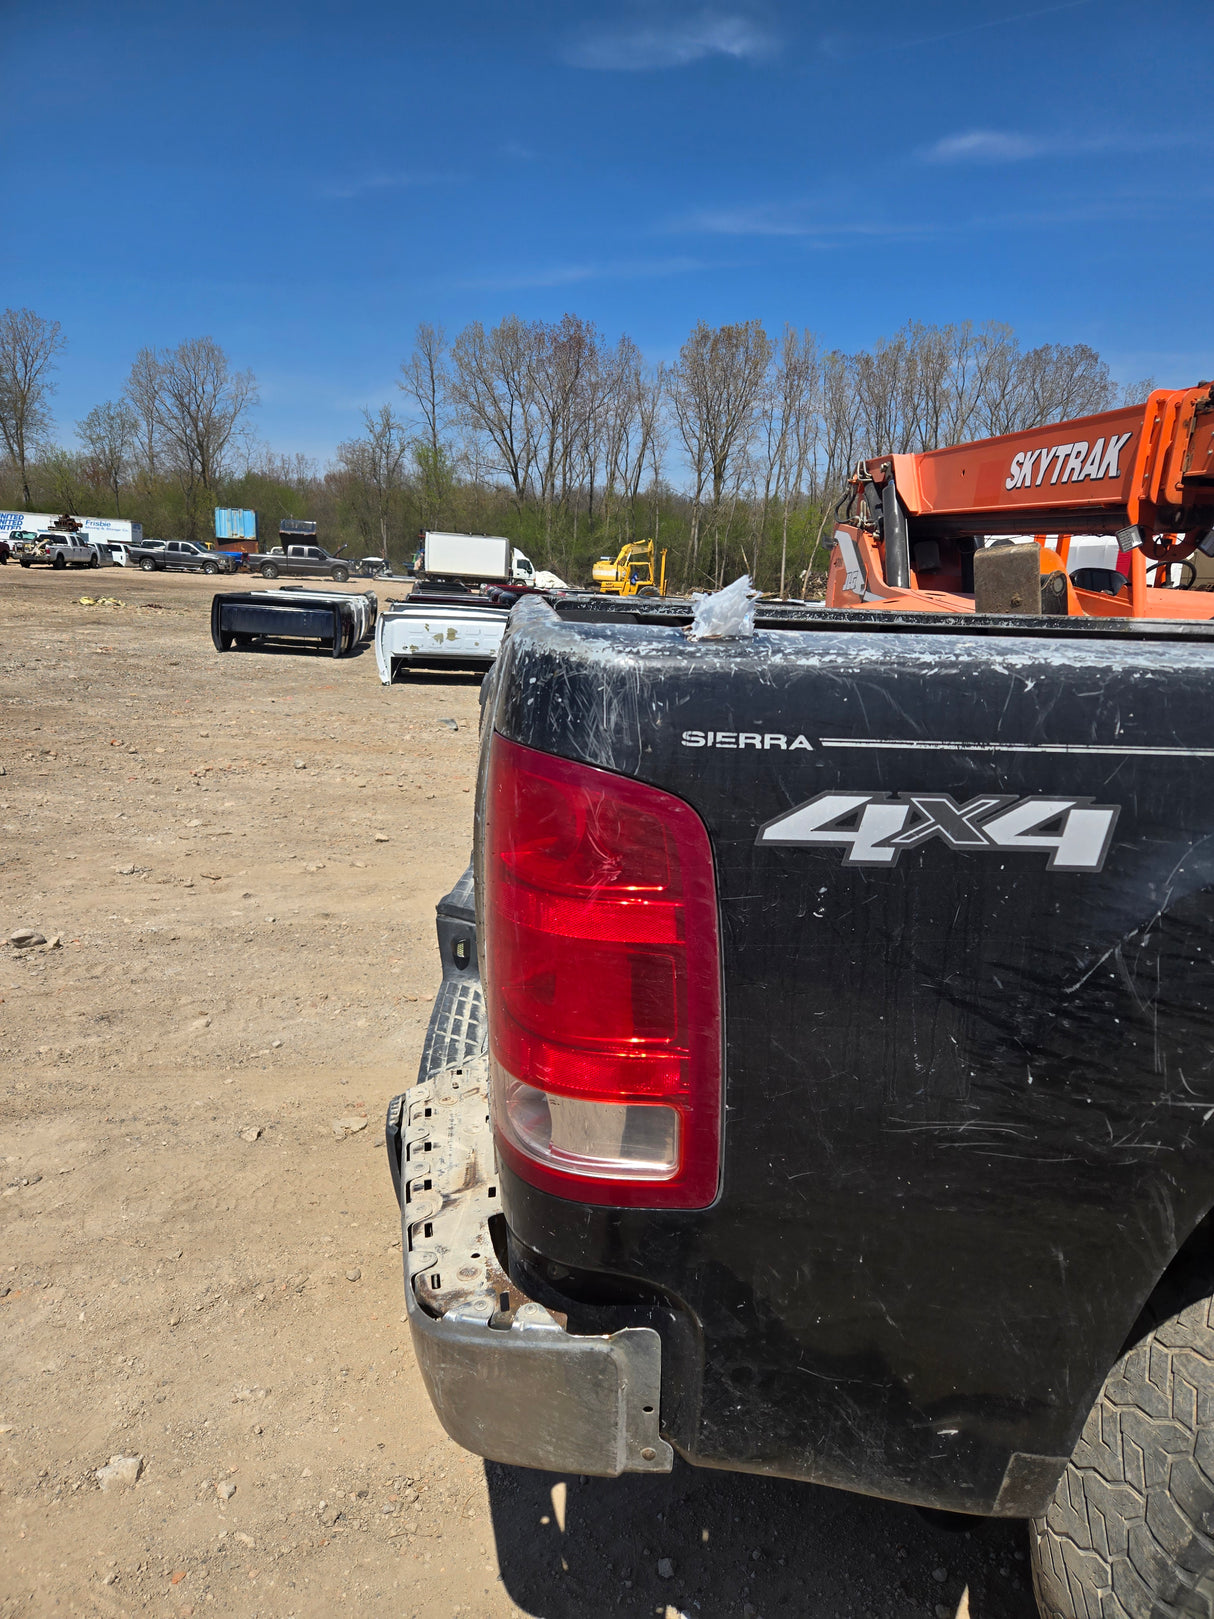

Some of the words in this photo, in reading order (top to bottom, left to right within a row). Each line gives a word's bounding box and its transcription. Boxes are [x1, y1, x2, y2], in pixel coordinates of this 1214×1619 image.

[1005, 432, 1133, 491] SKYTRAK
[85, 519, 111, 527] Frisbie
[681, 730, 814, 751] SIERRA
